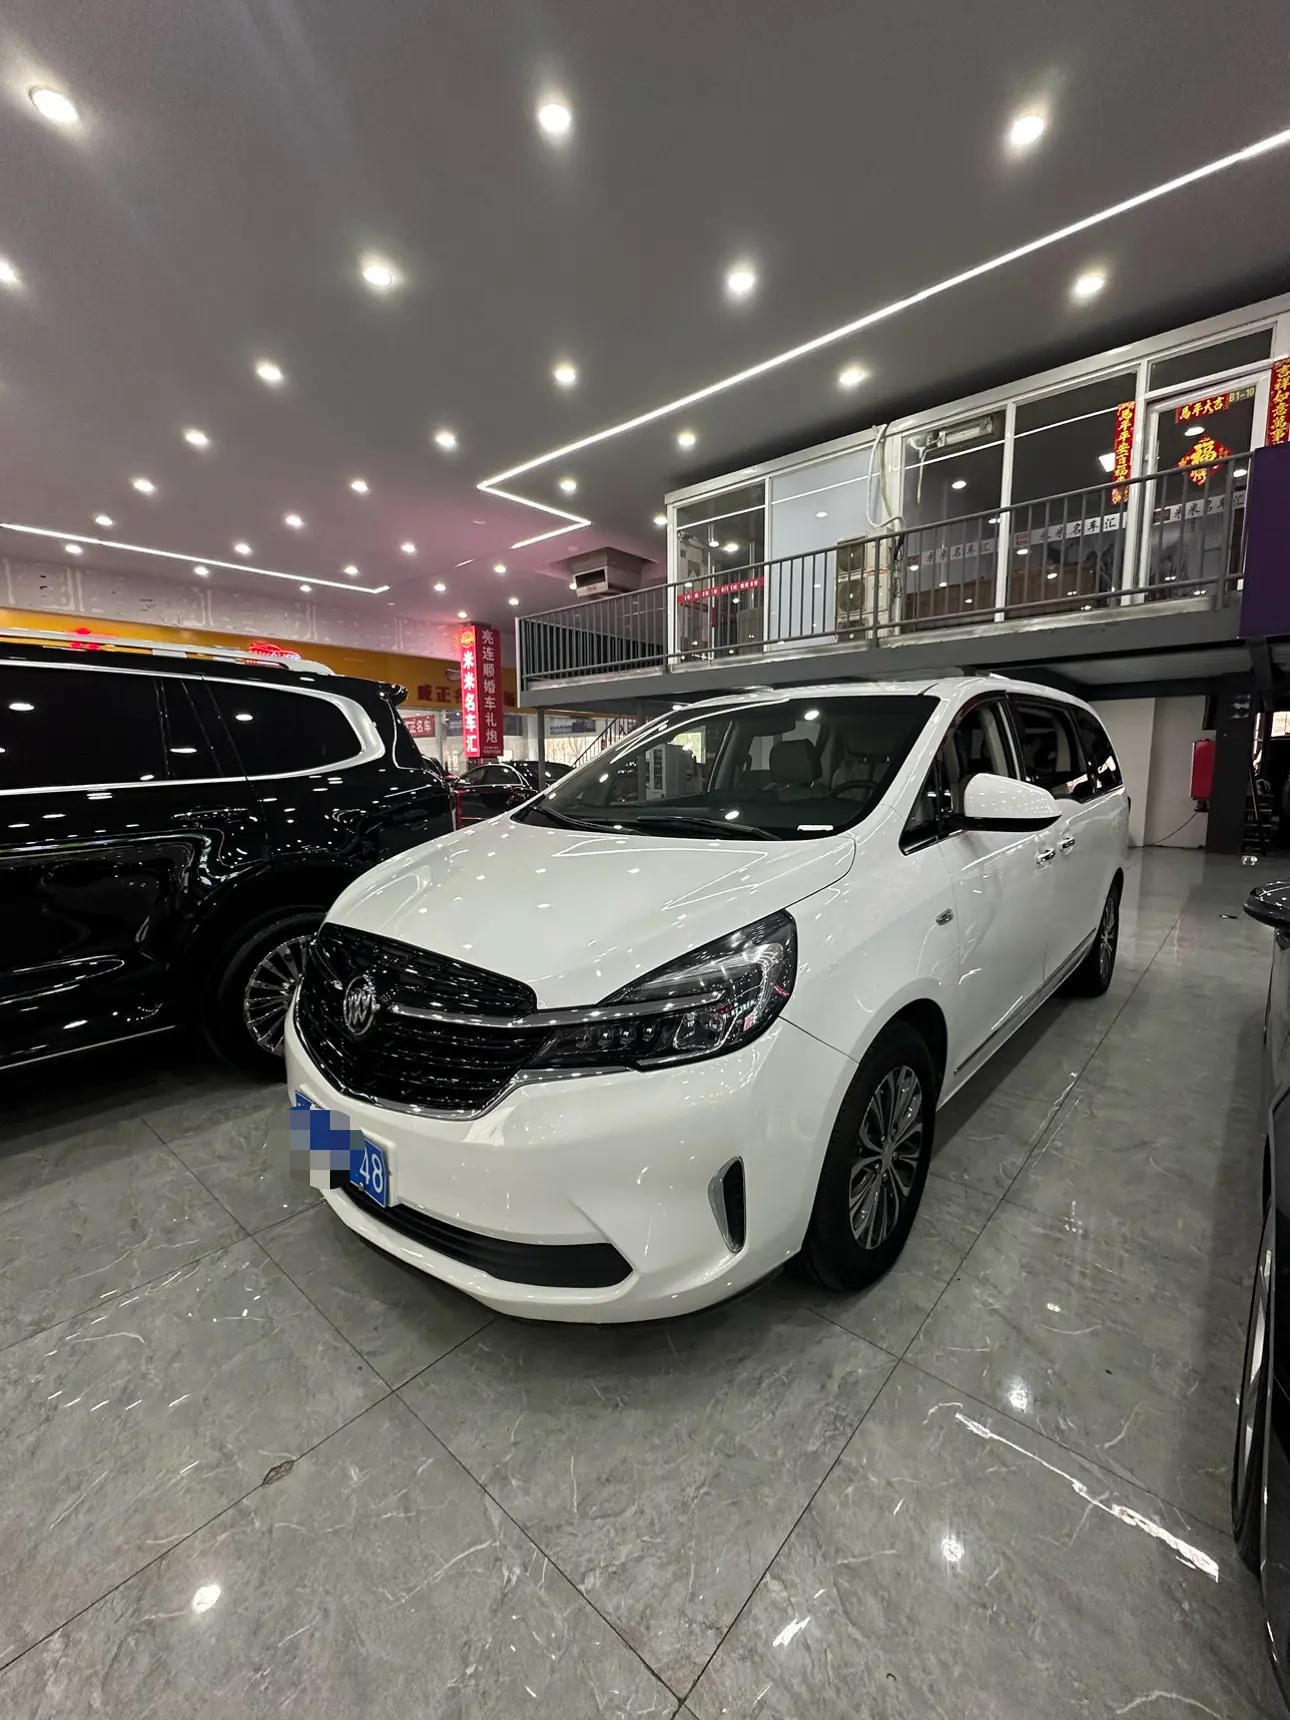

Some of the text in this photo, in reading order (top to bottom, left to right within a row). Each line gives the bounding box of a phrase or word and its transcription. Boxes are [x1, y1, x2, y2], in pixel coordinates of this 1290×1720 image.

[1229, 387, 1255, 402] B1-10
[462, 650, 478, 753] 米米名车汇
[359, 1146, 384, 1193] 48
